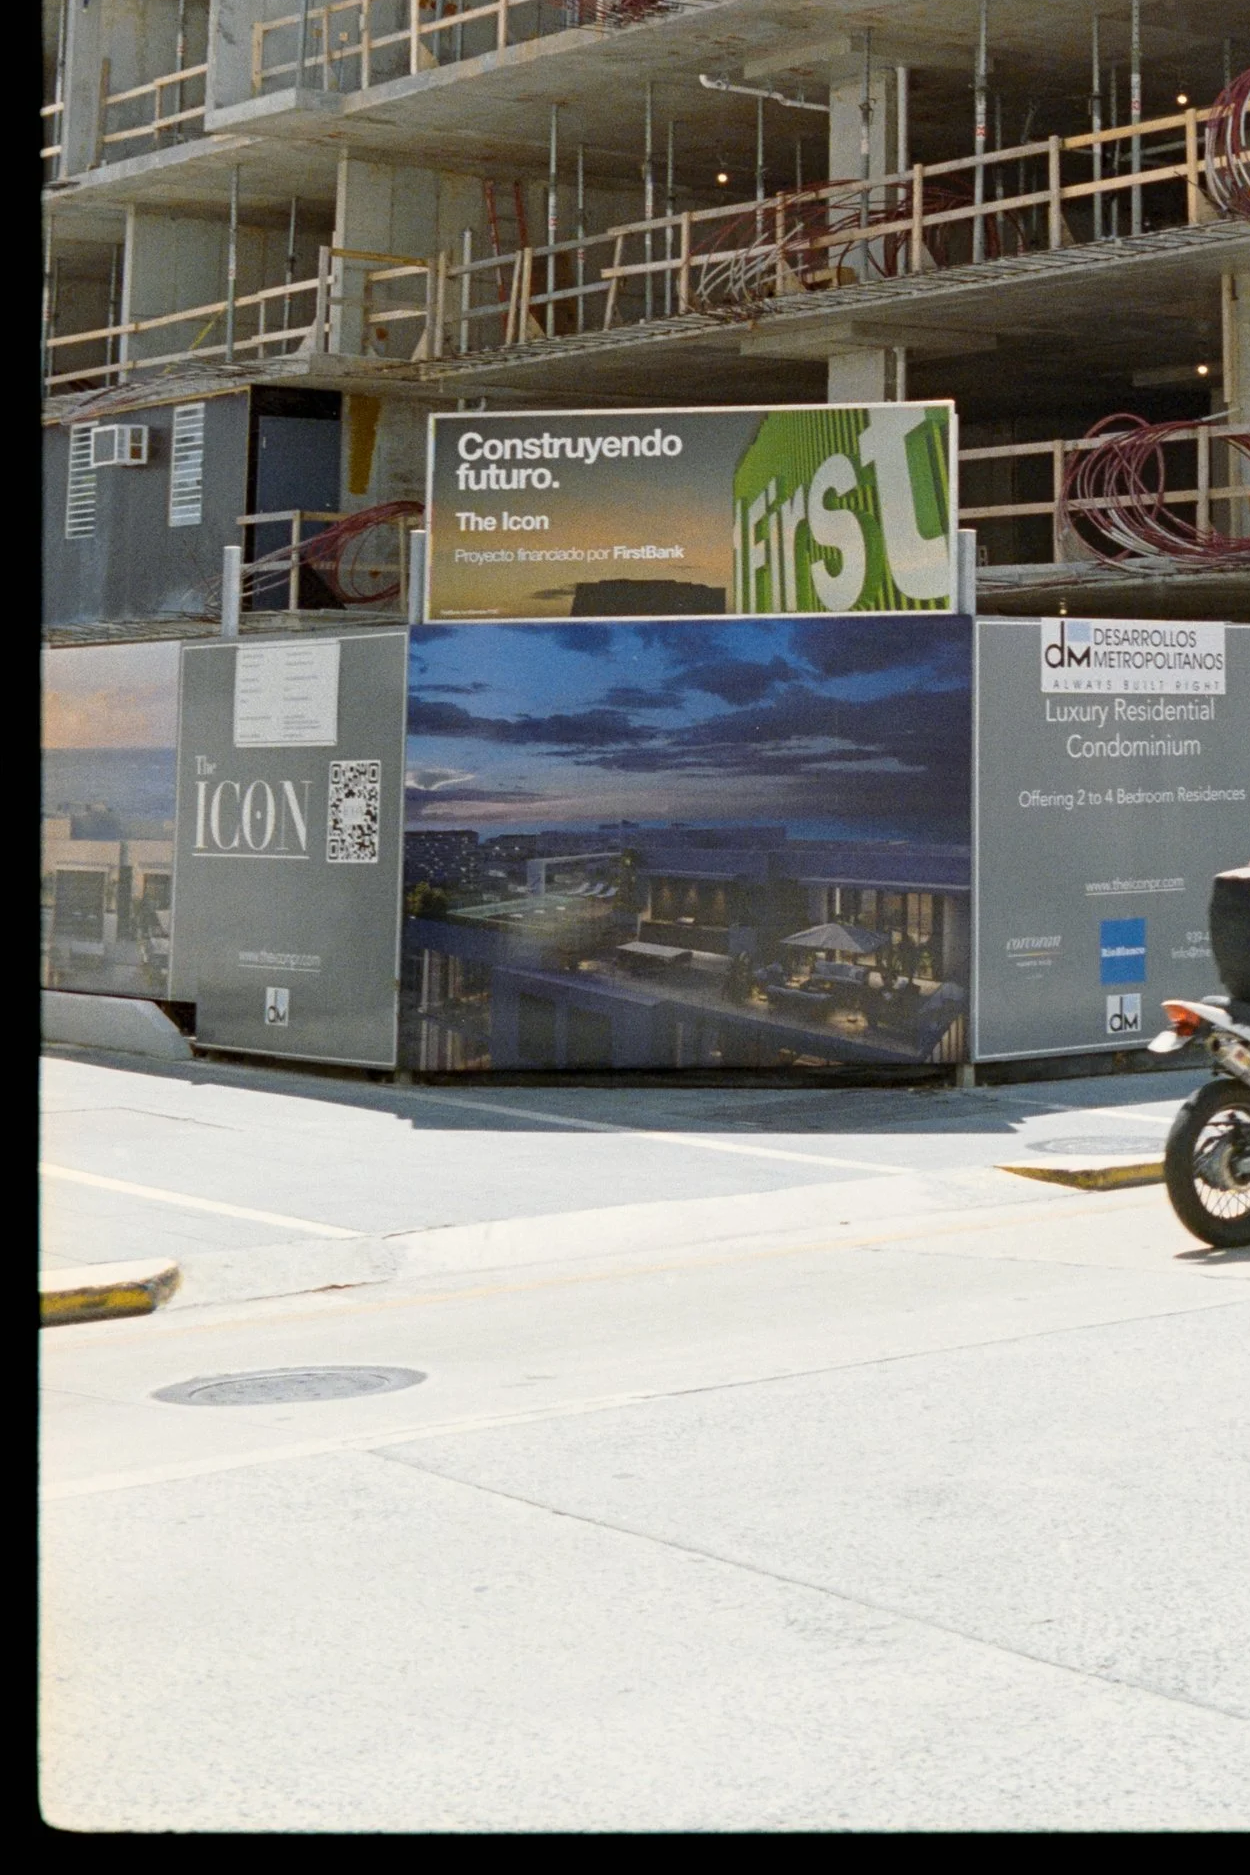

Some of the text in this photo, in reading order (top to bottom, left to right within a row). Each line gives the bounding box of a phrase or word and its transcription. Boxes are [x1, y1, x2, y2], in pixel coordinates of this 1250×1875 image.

[457, 428, 683, 464] Construyendo
[456, 463, 560, 491] futuro.
[455, 511, 549, 532] The Icon
[455, 546, 685, 566] Proyecto financiado por FirstBank
[1093, 628, 1197, 648] DESARROLLOS
[1093, 650, 1223, 670] METROPOLITANOS
[1053, 679, 1220, 691] ALWAYS BUILT RIGHT
[1046, 697, 1215, 728] Luxury Residential
[1067, 733, 1200, 758] Condominium
[1018, 785, 1246, 809] Offering 2 to 4 Bedroom Residences
[194, 780, 313, 851] ICON
